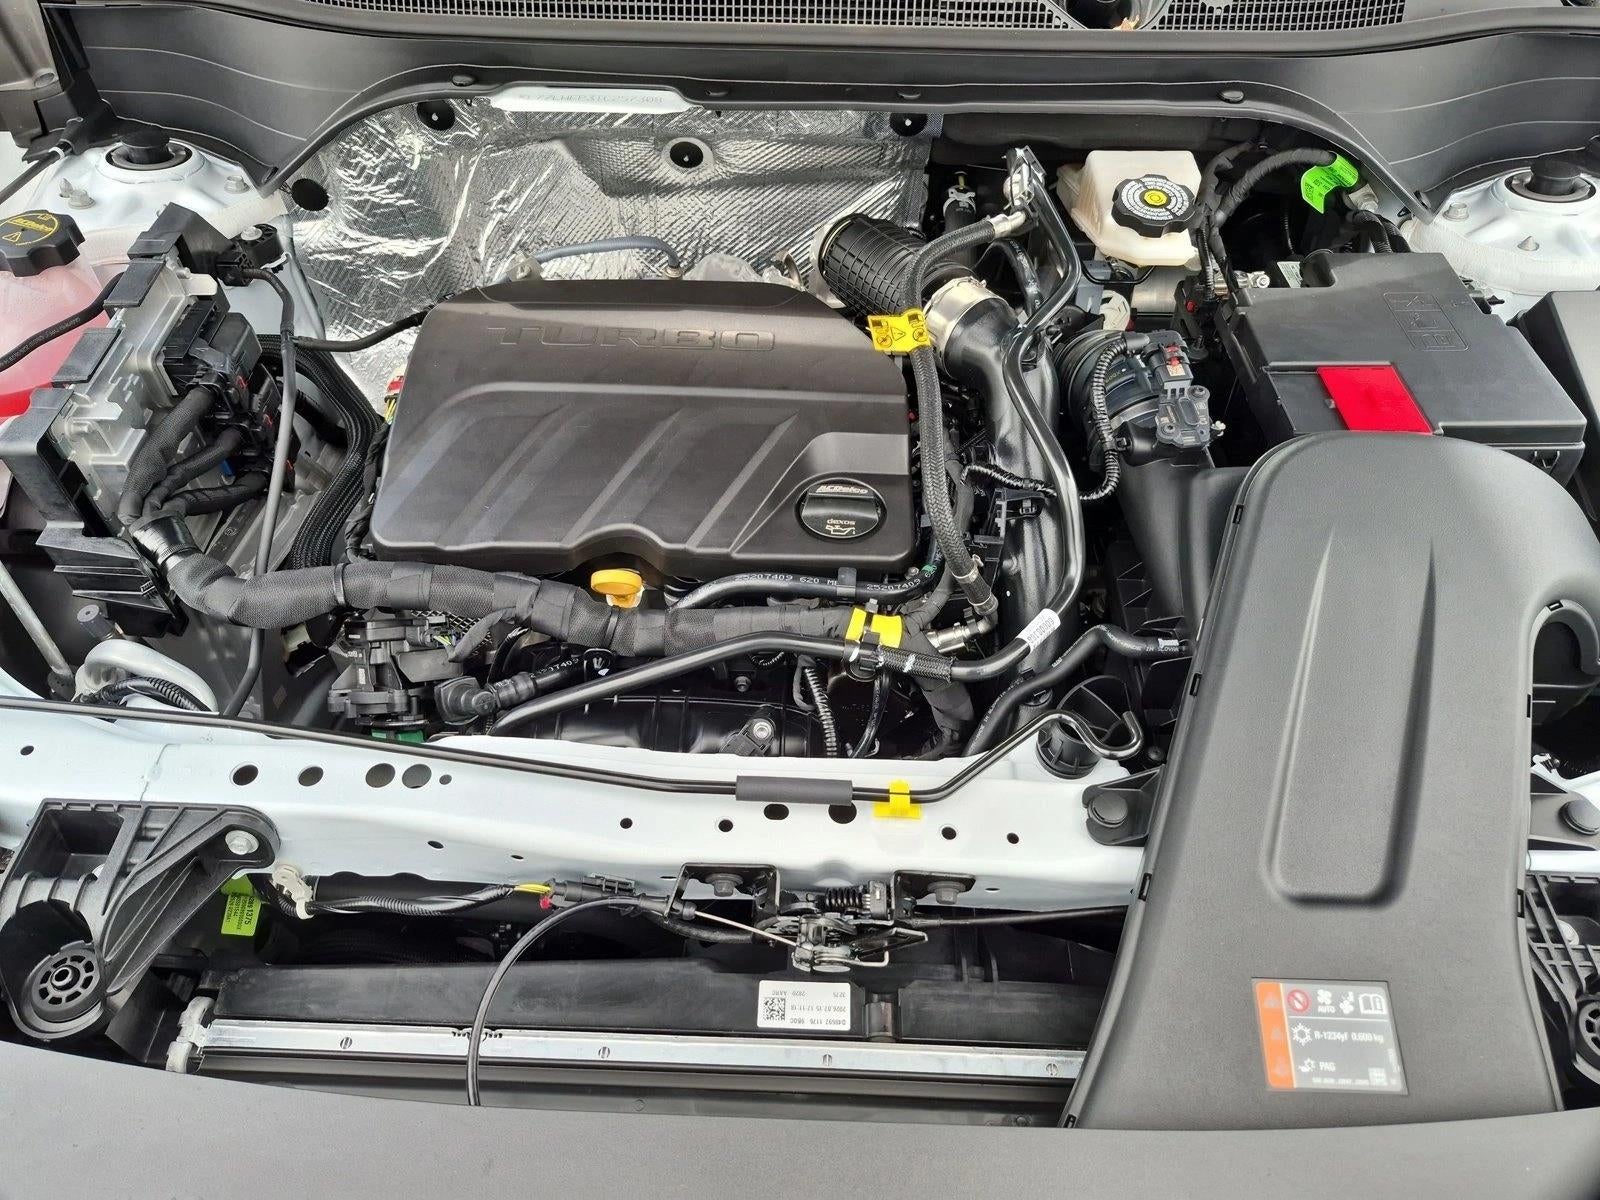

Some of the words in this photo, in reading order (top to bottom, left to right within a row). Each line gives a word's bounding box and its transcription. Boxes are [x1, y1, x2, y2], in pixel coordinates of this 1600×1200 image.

[487, 327, 775, 350] TURBO
[815, 485, 869, 494] ACDelco
[799, 576, 820, 584] 620
[1317, 1004, 1336, 1014] AUTO
[1319, 1061, 1337, 1073] PAG
